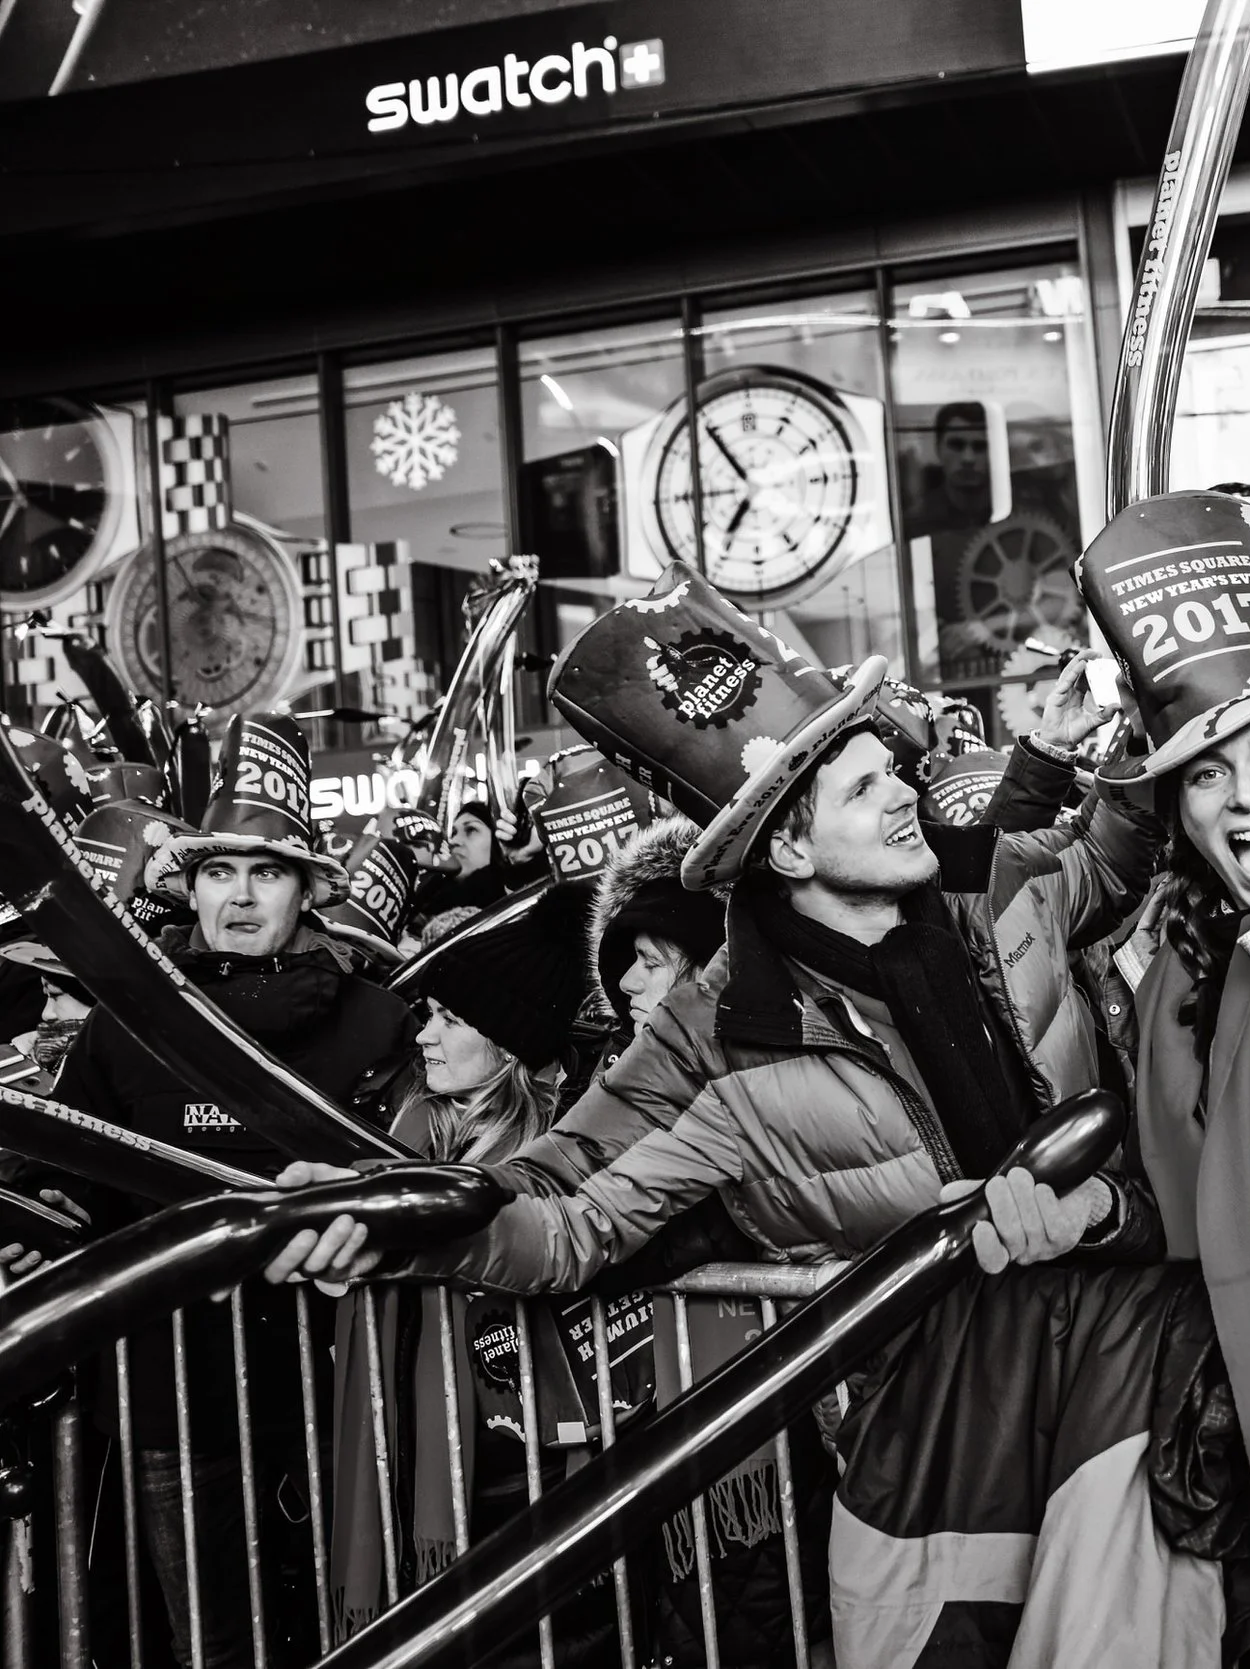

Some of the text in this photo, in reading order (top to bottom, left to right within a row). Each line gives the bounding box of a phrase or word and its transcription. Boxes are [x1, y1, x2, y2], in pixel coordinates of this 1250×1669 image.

[365, 36, 617, 132] swatch
[1149, 150, 1181, 261] planet
[1111, 562, 1180, 597] TIMES
[1119, 589, 1164, 617] NEW
[1163, 573, 1230, 600] YEAR'S
[678, 656, 734, 719] planet
[695, 658, 756, 720] fitness
[238, 746, 270, 763] NEW
[241, 732, 281, 755] TIMES
[234, 761, 309, 823] 2017
[753, 775, 786, 808] 2017
[938, 789, 964, 809] NEW
[543, 797, 631, 831] TIMES SQUARE
[548, 829, 574, 843] NEW
[612, 809, 636, 825] EVE
[21, 791, 105, 892] planet
[81, 850, 123, 869] QUARE
[554, 822, 640, 873] 2017
[131, 896, 171, 915] plan
[350, 870, 400, 931] 2017
[1002, 931, 1037, 969] Marmot
[43, 1100, 151, 1152] fitness
[473, 1324, 517, 1351] fitness
